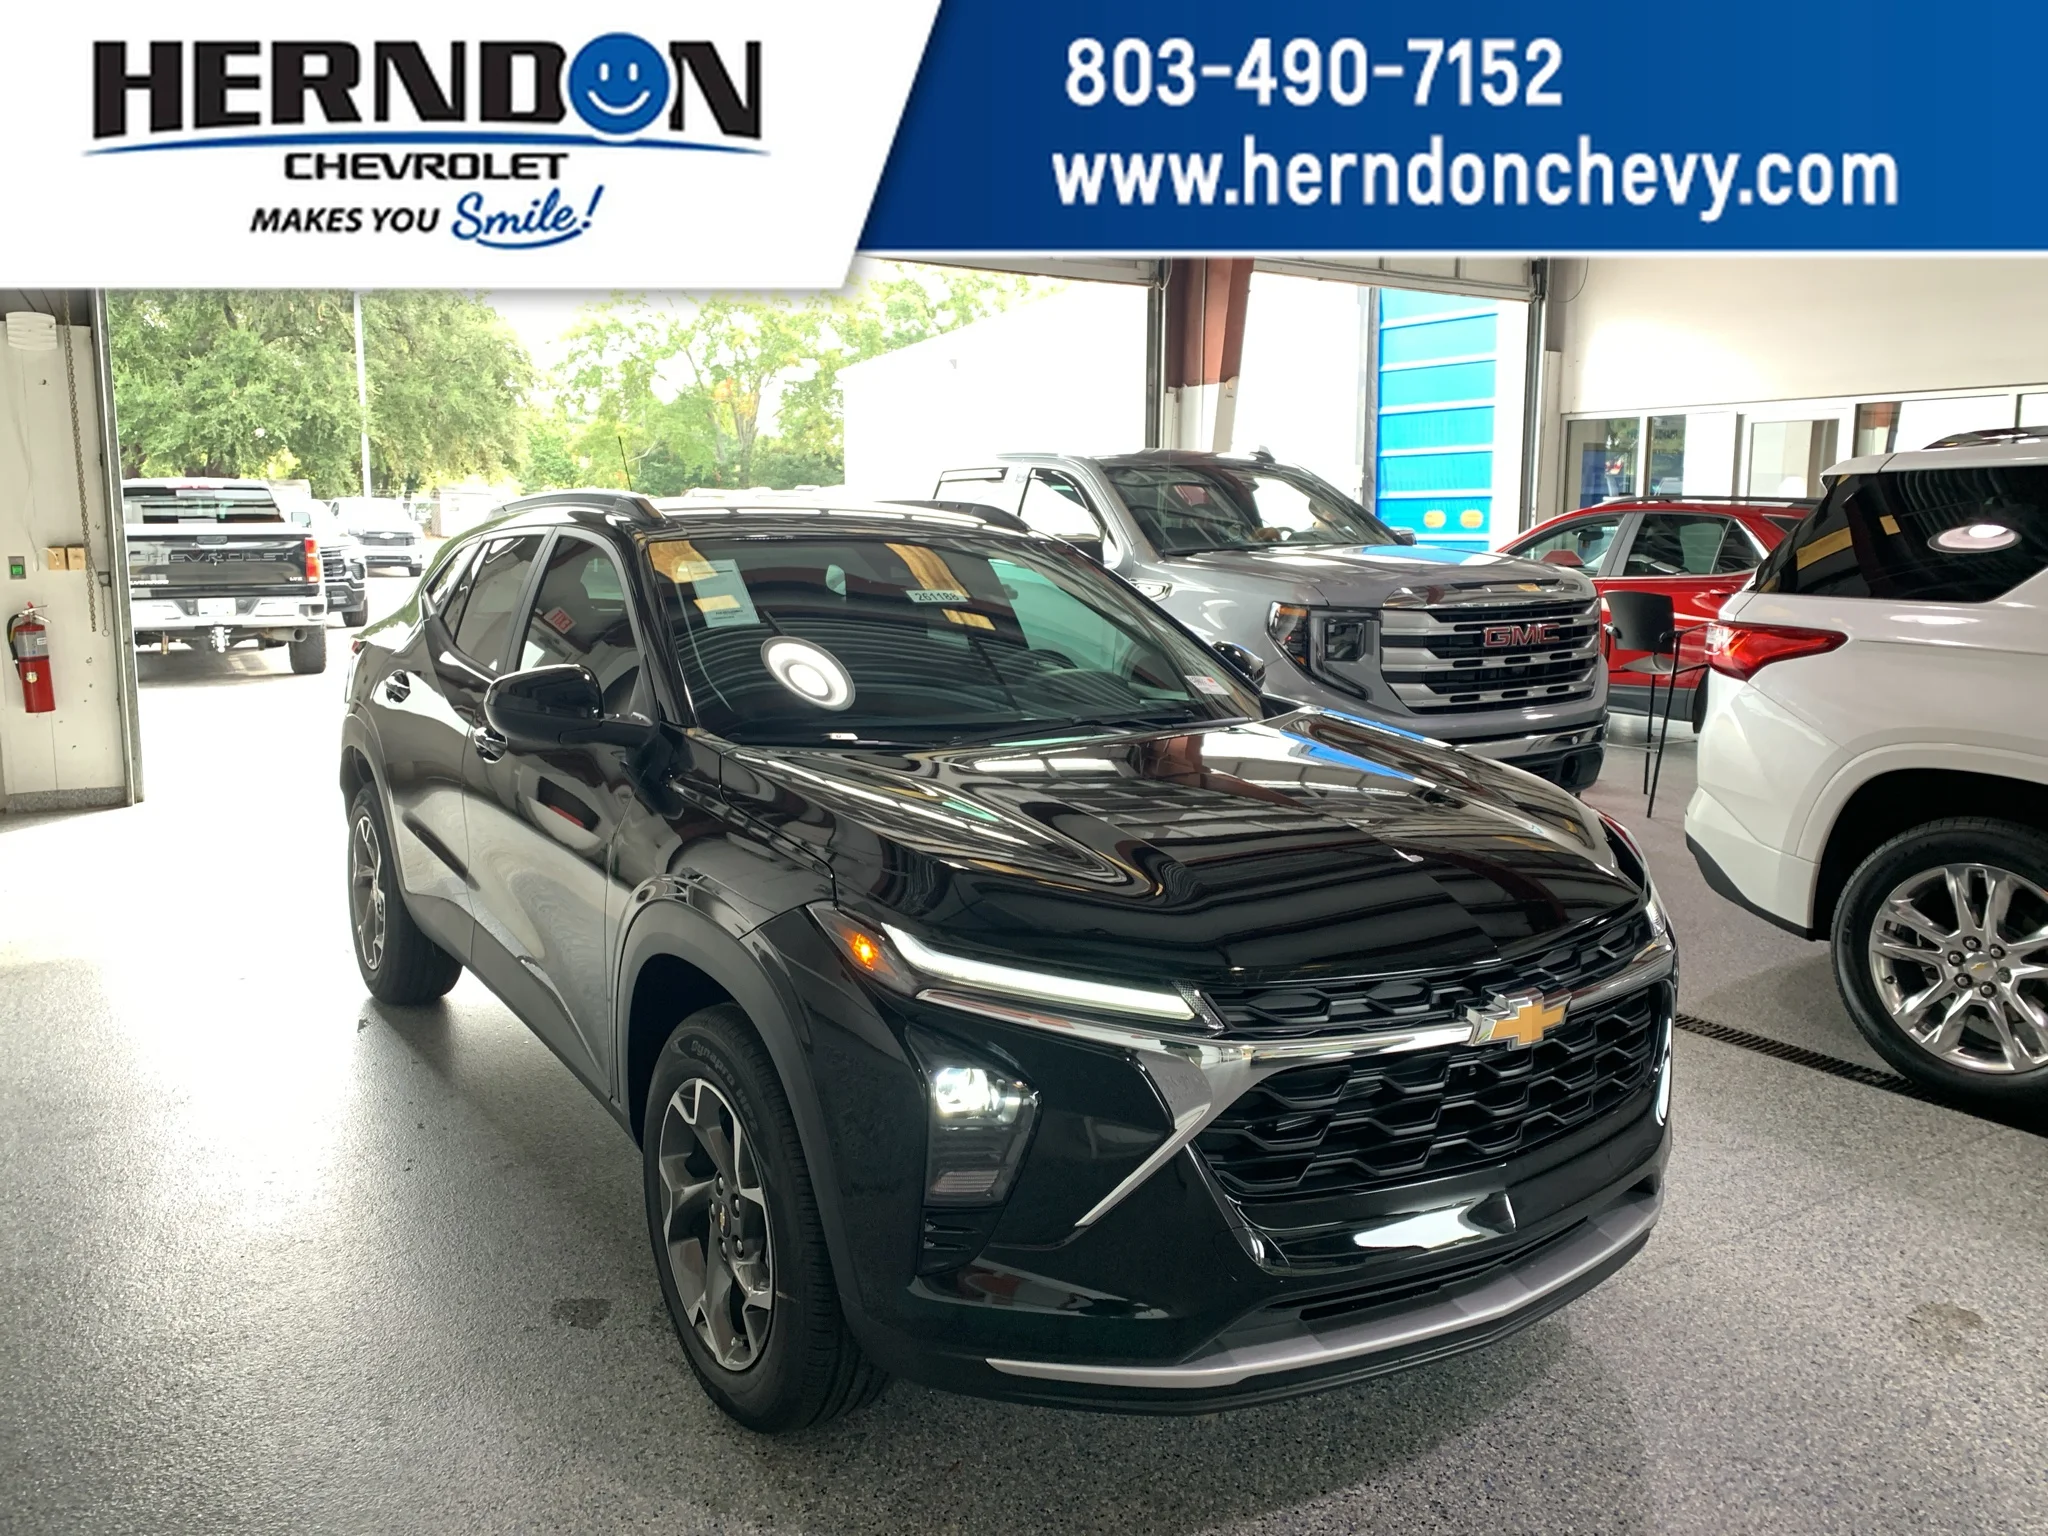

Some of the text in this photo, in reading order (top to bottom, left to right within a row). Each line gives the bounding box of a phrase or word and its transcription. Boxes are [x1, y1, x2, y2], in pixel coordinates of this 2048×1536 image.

[129, 552, 293, 564] CHEVROLET
[1484, 623, 1560, 647] GMC
[691, 1040, 736, 1087] Dynapro
